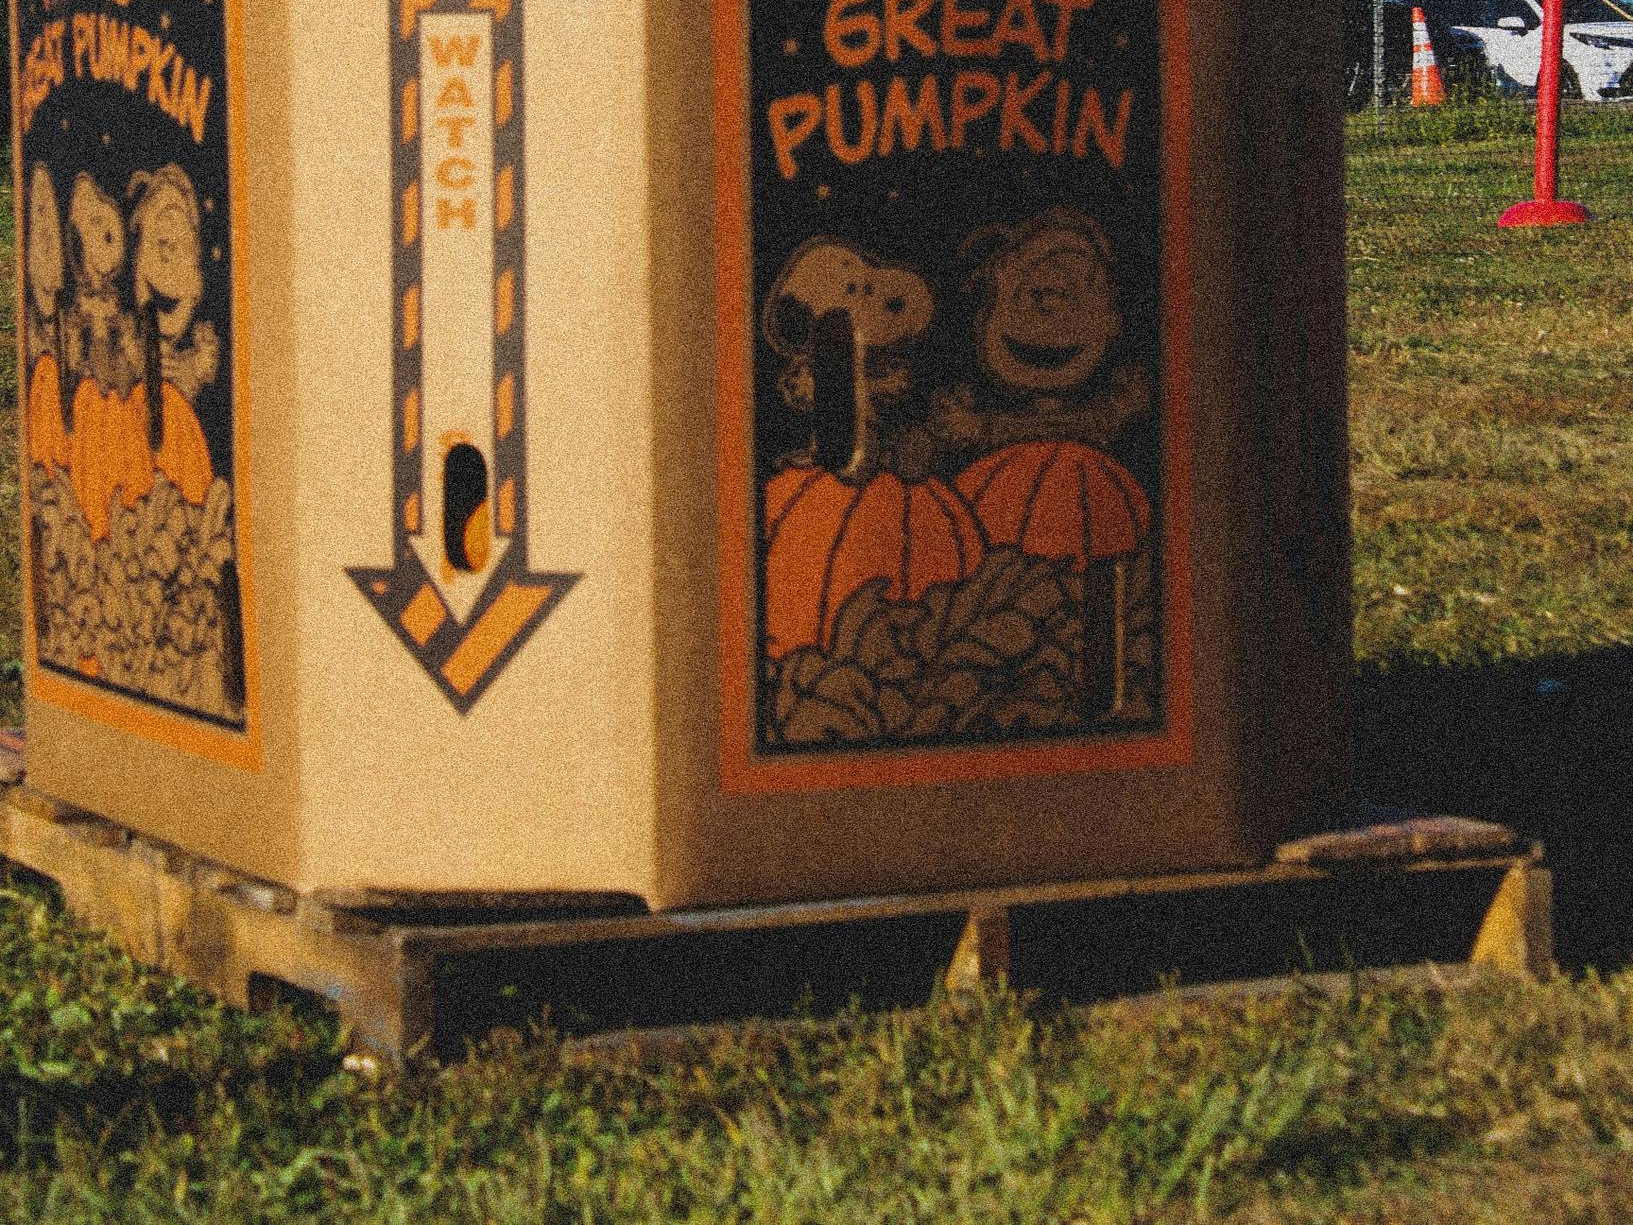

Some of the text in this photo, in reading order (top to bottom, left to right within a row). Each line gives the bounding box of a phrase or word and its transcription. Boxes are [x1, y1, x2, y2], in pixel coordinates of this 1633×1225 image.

[71, 11, 214, 145] PUMPKIN
[427, 34, 482, 232] WATCH
[766, 69, 1136, 181] PUMPKIN
